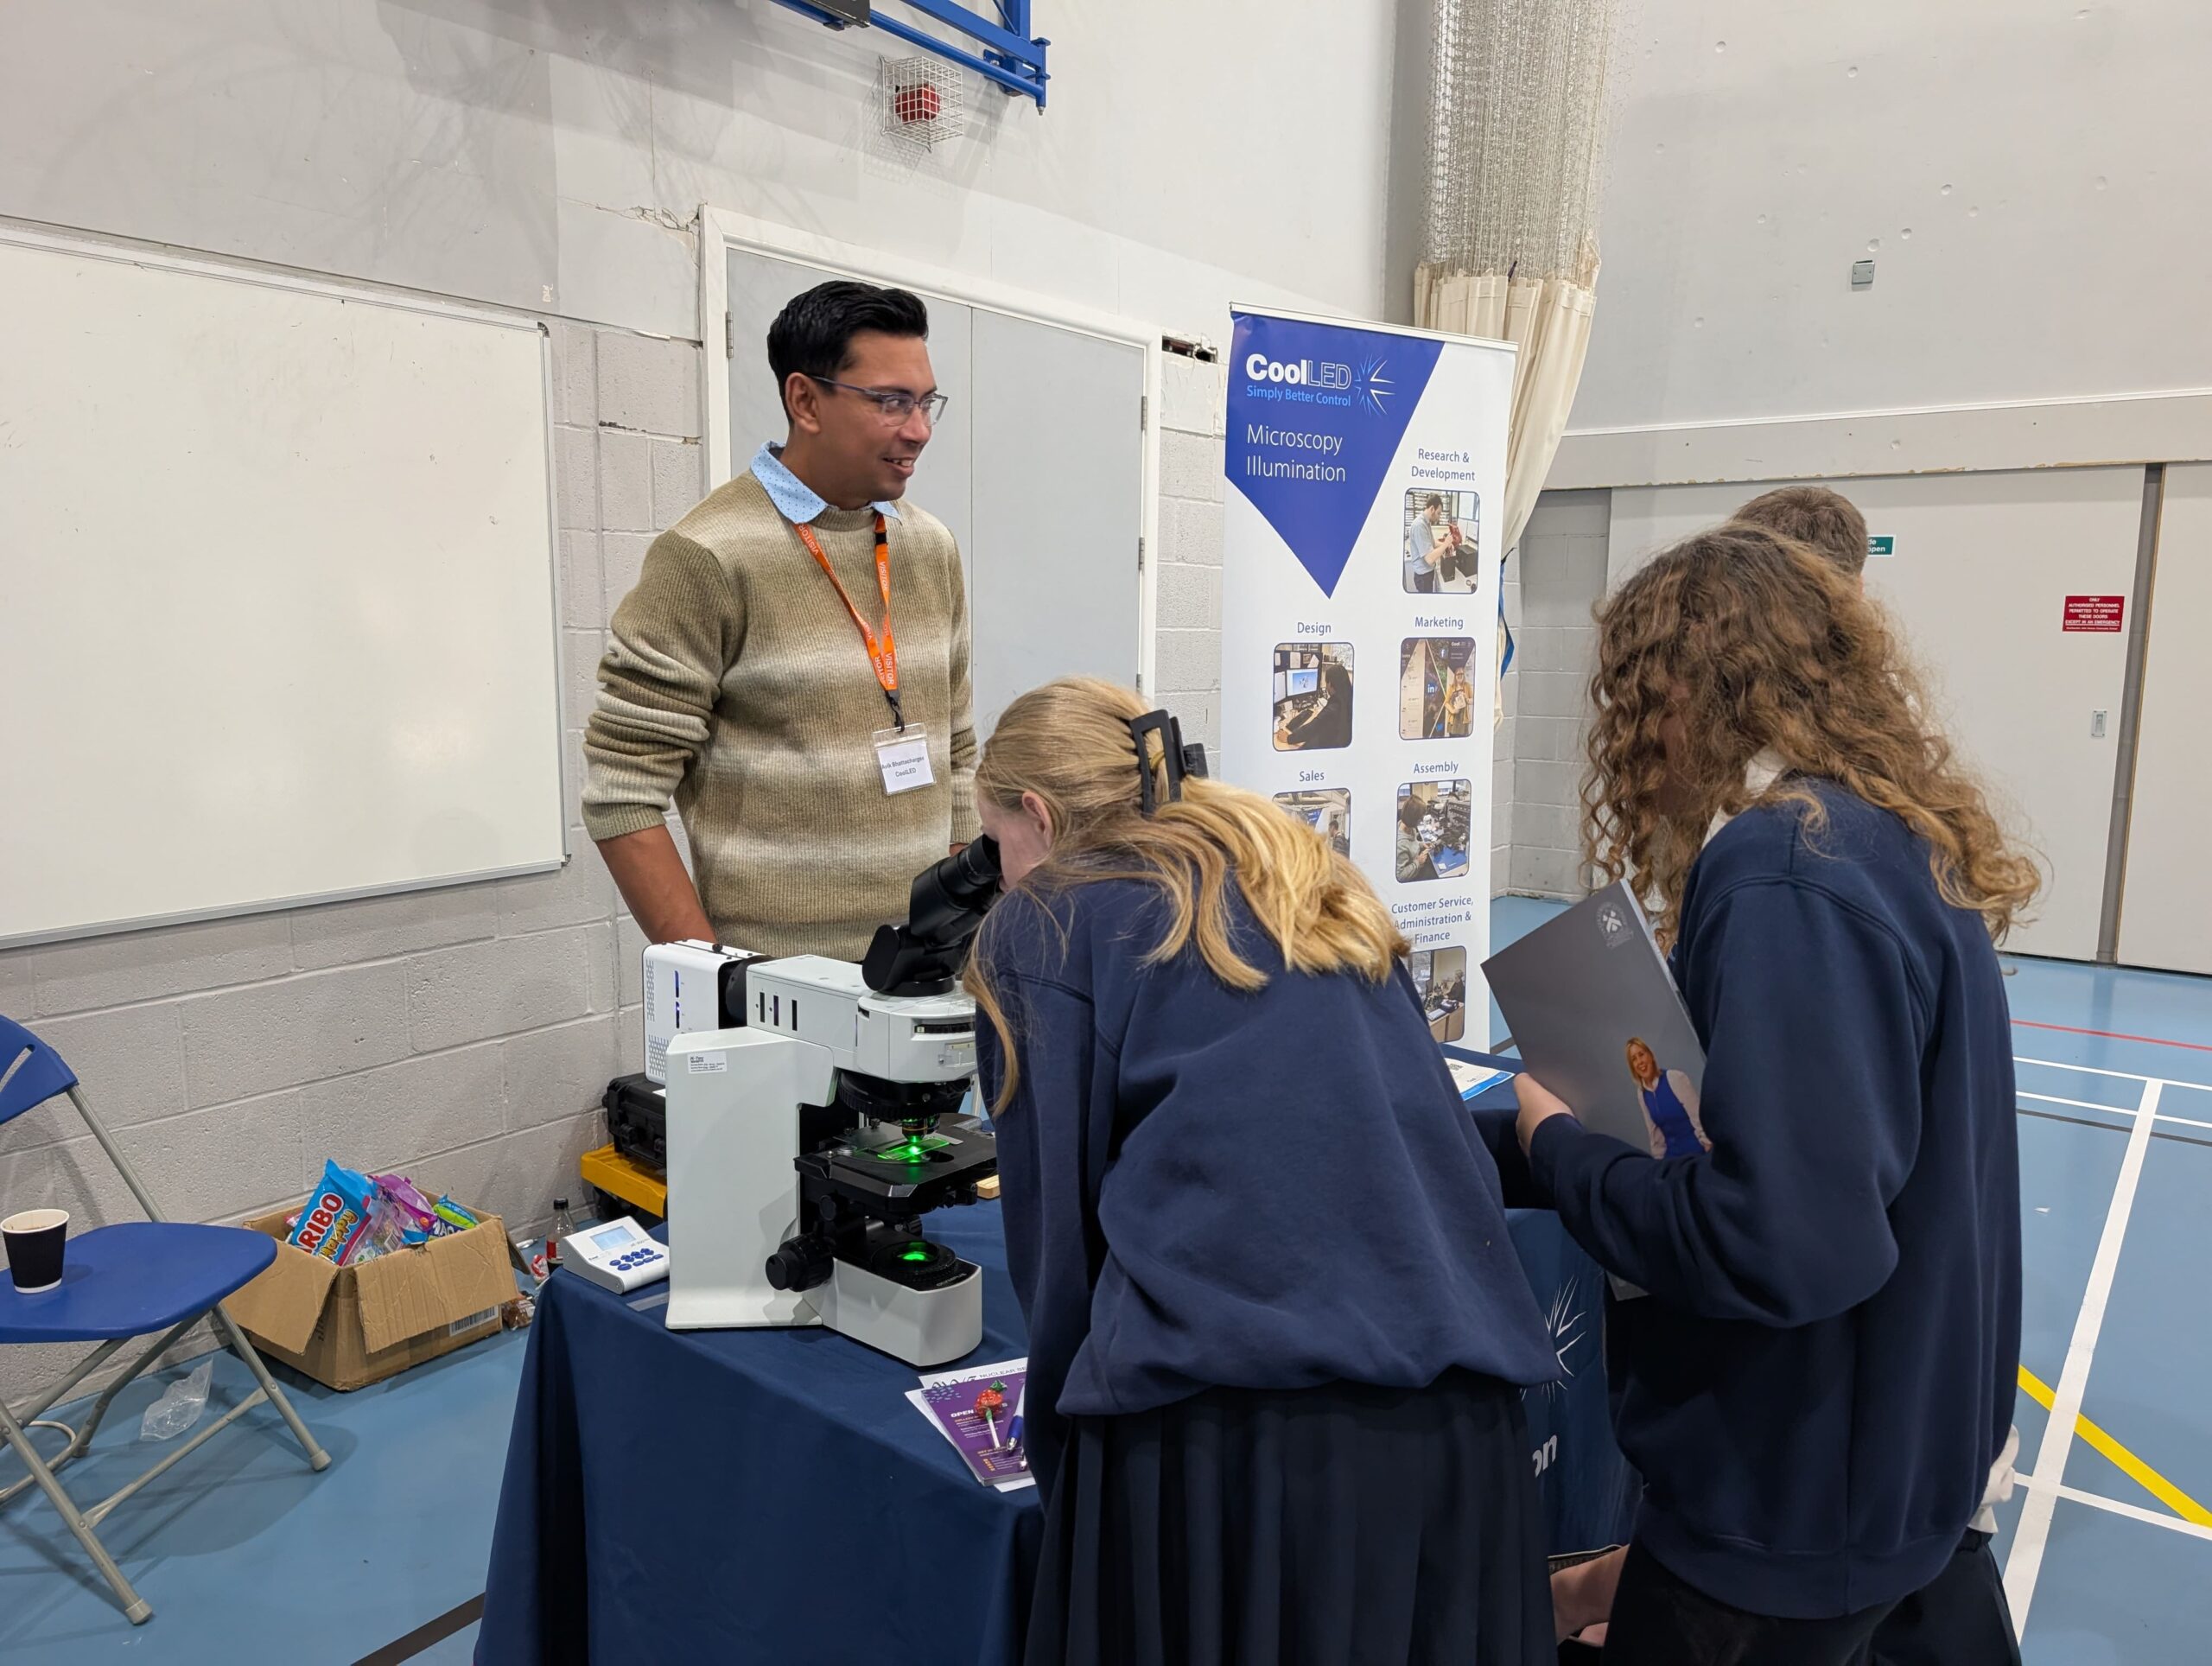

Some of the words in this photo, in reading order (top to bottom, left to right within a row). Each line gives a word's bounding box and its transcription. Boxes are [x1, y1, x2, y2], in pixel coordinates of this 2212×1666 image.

[1246, 353, 1351, 389] CoolLED
[1247, 385, 1283, 401] Simply
[1285, 389, 1314, 403] Better
[1316, 392, 1351, 407] Control
[1247, 423, 1343, 456] Microscopy
[1418, 448, 1460, 463] Research
[1462, 452, 1470, 463] &
[1247, 455, 1346, 482] Illumination
[1411, 465, 1476, 482] Development
[1297, 620, 1332, 635] Design
[1414, 615, 1464, 631] Marketing
[886, 652, 894, 685] VISITOR
[895, 767, 917, 778] CoolLED
[1299, 769, 1325, 783] Sales
[1413, 761, 1459, 776] Assembly
[1391, 900, 1437, 914] Customer
[1439, 895, 1474, 909] Service,
[1394, 912, 1463, 930] Administration
[1465, 911, 1471, 921] &
[1414, 932, 1451, 944] Finance
[979, 1369, 1016, 1378] NUCLEAR
[950, 1408, 975, 1418] OPEN
